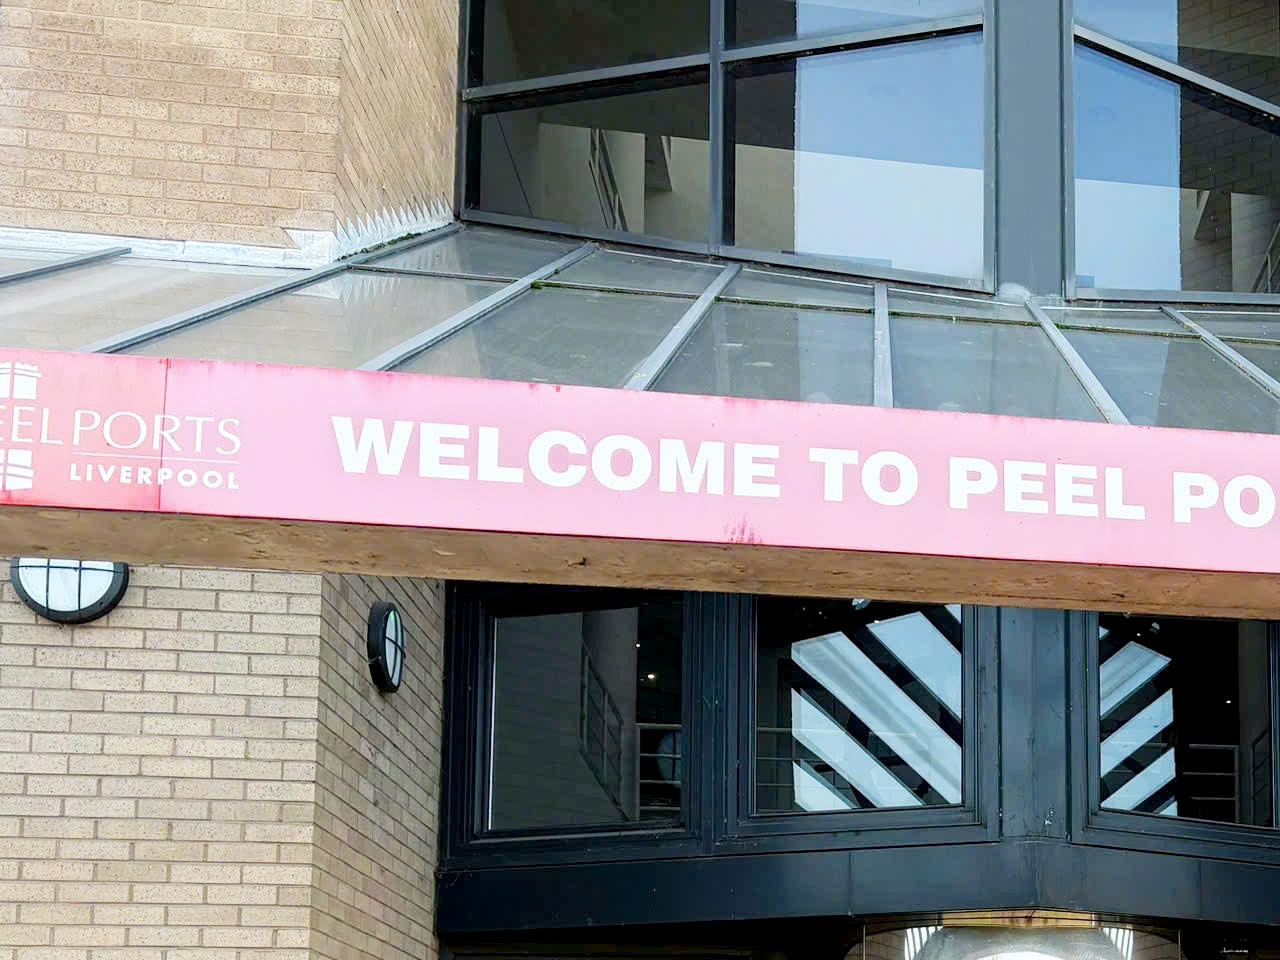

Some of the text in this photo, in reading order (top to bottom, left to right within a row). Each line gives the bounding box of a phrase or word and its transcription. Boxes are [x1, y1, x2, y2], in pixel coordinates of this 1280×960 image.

[72, 408, 242, 456] PORTS
[69, 463, 240, 490] LIVERPOOL
[331, 415, 781, 499] WELCOME
[808, 447, 918, 506] TO
[948, 456, 1146, 521] PEEL
